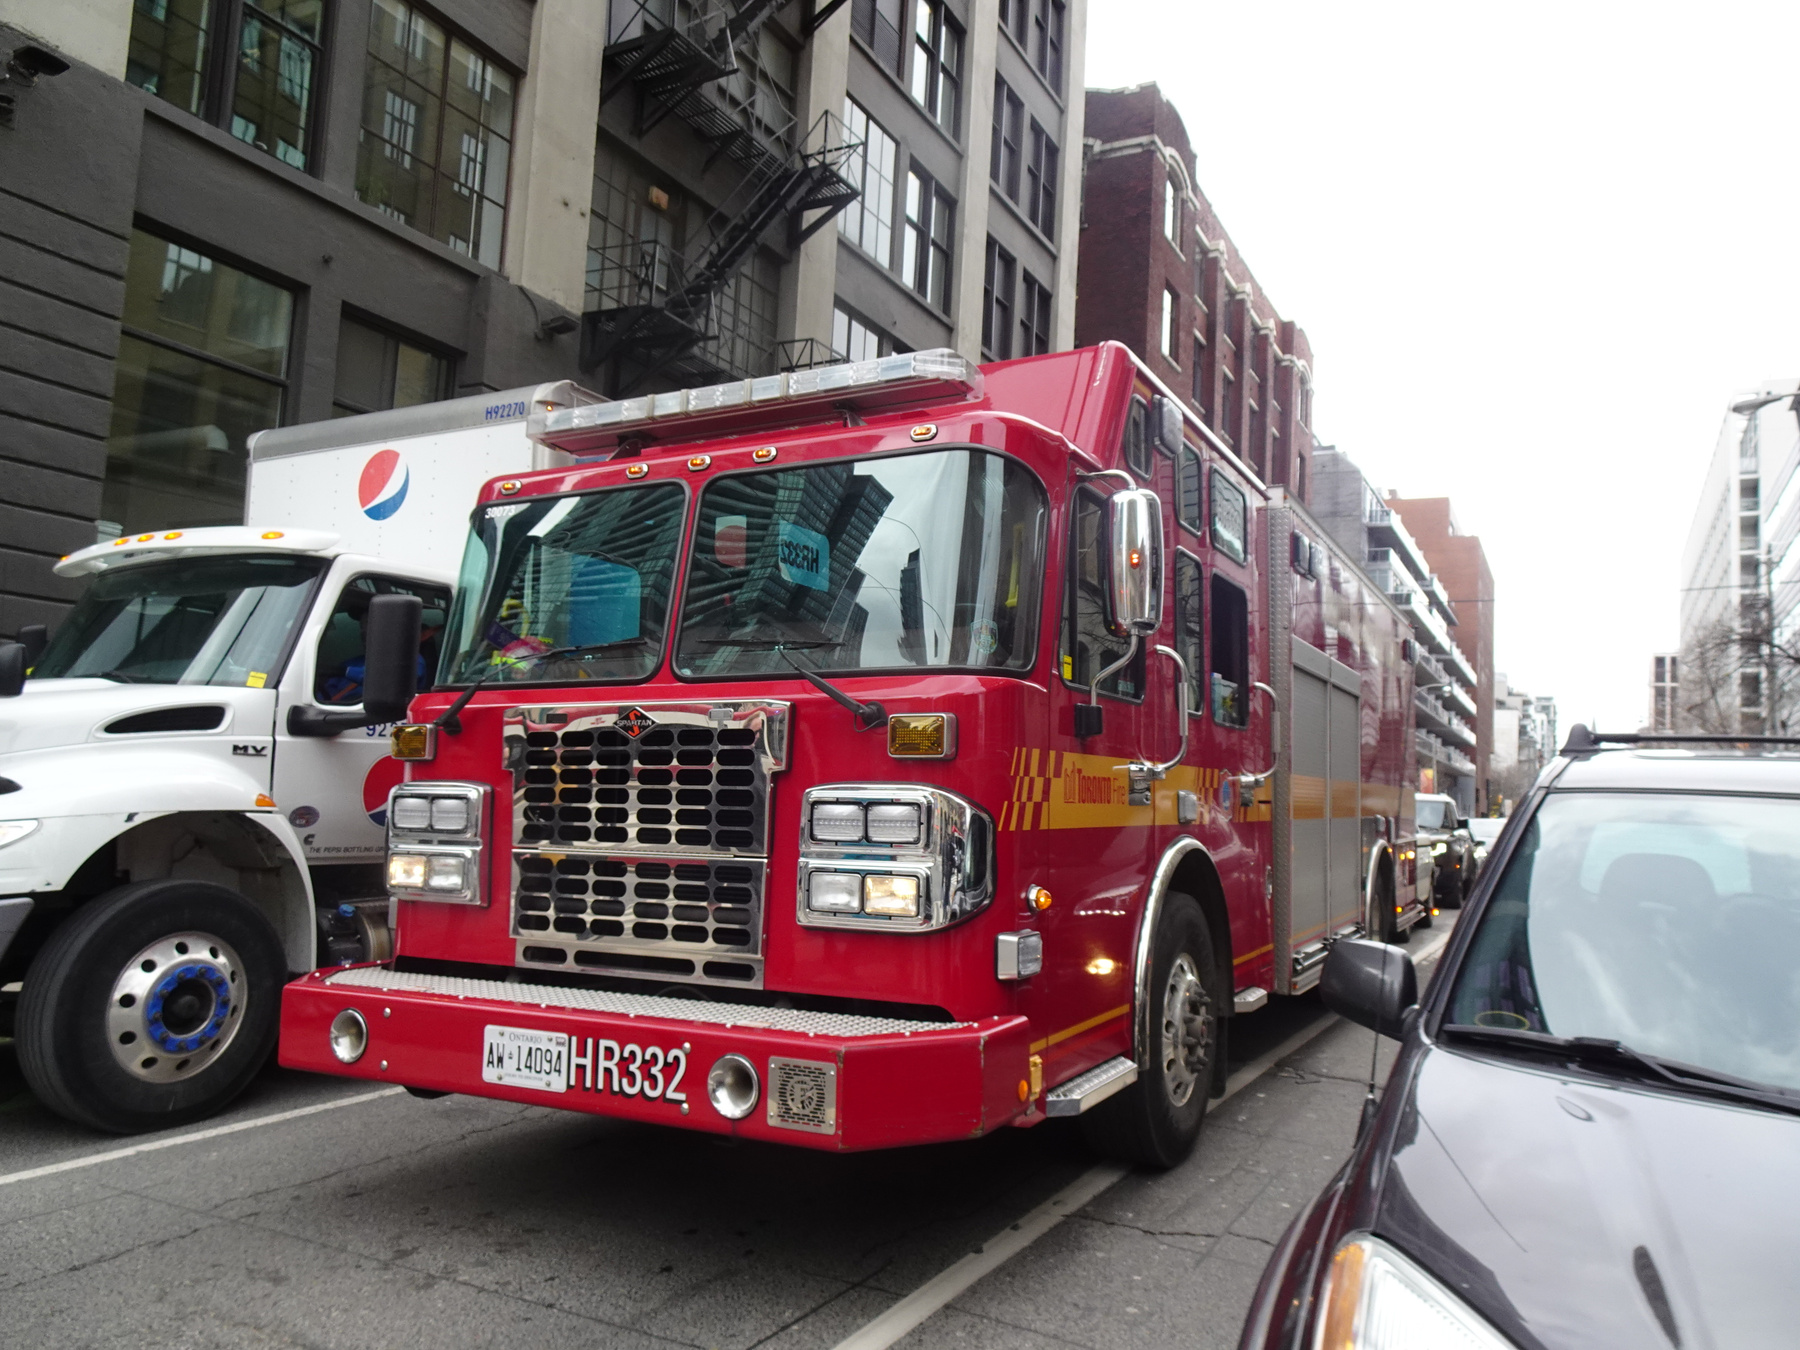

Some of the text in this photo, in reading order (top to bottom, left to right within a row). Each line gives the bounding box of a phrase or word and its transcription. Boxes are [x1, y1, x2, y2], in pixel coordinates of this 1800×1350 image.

[485, 401, 526, 420] H92270
[616, 719, 652, 727] SPARTAN
[232, 744, 268, 754] MV
[1077, 768, 1126, 805] TORONTO Fire
[509, 1032, 542, 1044] ONTARIO
[516, 1045, 562, 1077] 14094
[568, 1035, 687, 1101] HR332
